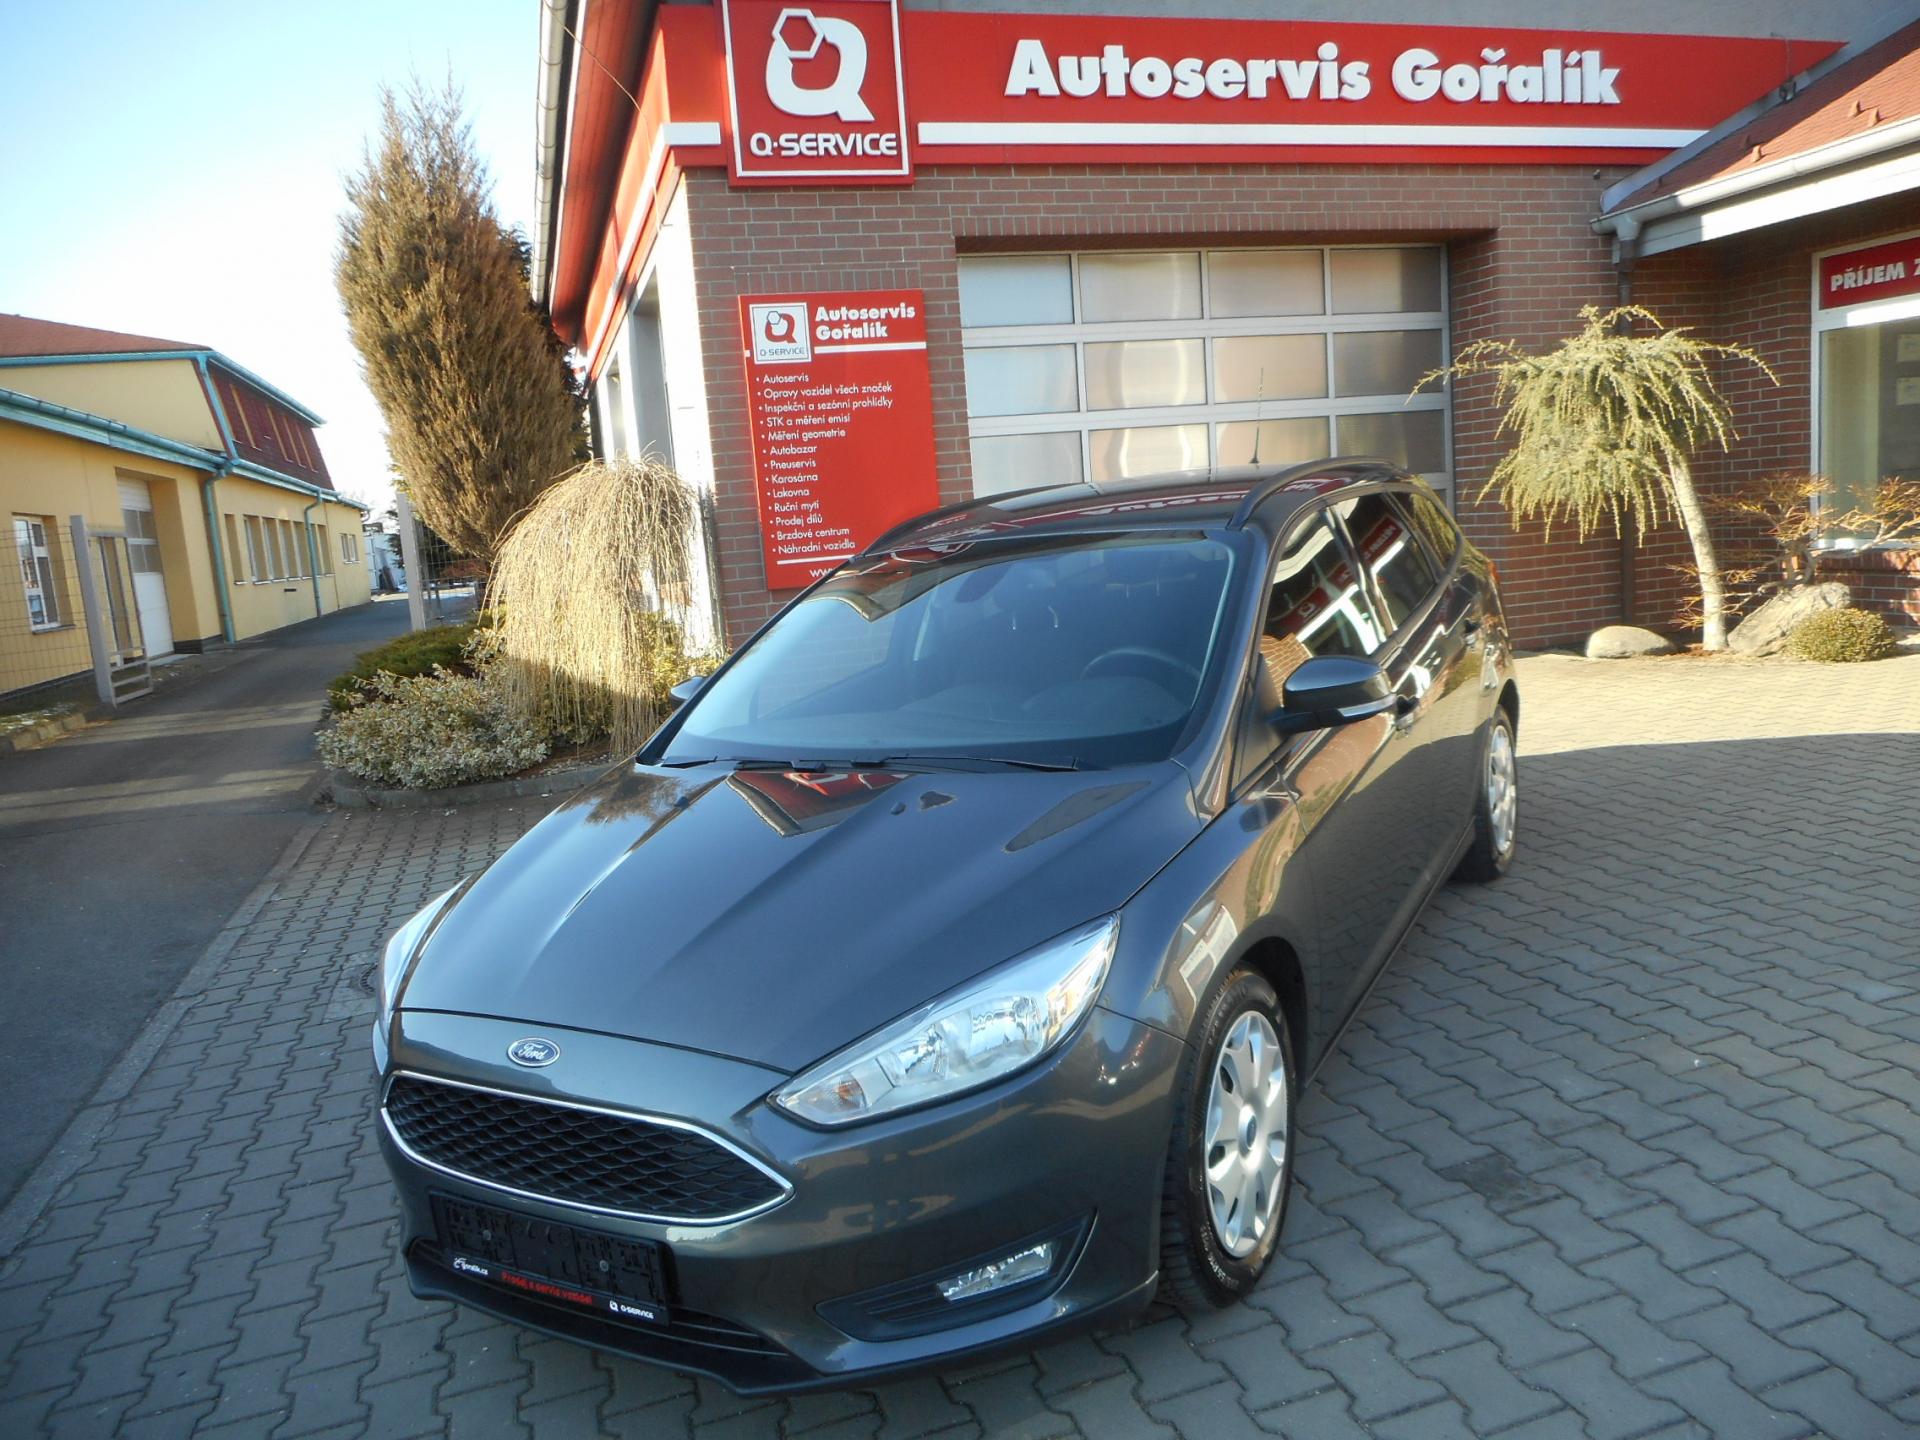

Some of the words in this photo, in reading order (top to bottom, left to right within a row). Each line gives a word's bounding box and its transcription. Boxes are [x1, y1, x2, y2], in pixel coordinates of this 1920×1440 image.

[1004, 39, 1371, 100] Autoservis
[1392, 47, 1621, 105] Gořalík
[1830, 261, 1906, 292] PŘÍJEM
[815, 302, 916, 322] Autoservis
[815, 322, 888, 341] Gořalík
[763, 373, 809, 384] Autoservis
[763, 388, 798, 400] Opravy
[800, 385, 832, 397] vozidel
[834, 384, 859, 395] všech
[862, 381, 892, 393] značek
[764, 401, 806, 414] Inspekční
[808, 403, 814, 411] a
[817, 399, 850, 411] sezónní
[852, 396, 893, 410] prohlídky
[766, 417, 784, 428] STK
[787, 418, 793, 426] a
[795, 414, 825, 425] měření
[827, 413, 850, 423] emisí
[768, 429, 799, 441] Měření
[802, 427, 846, 441] geometrie
[770, 444, 817, 456] Autobazar
[770, 459, 816, 470] Pneuservis
[771, 473, 818, 484] Karosárna
[773, 487, 809, 498] Lakovna
[774, 501, 798, 512] Ruční
[801, 500, 819, 512] mytí
[775, 515, 804, 528] Prodej
[806, 513, 823, 524] dílů
[777, 529, 813, 541] Brzdové
[815, 527, 850, 538] centrum
[778, 542, 821, 555] Náhradní
[823, 540, 855, 551] vozidla
[518, 1042, 549, 1060] Ford
